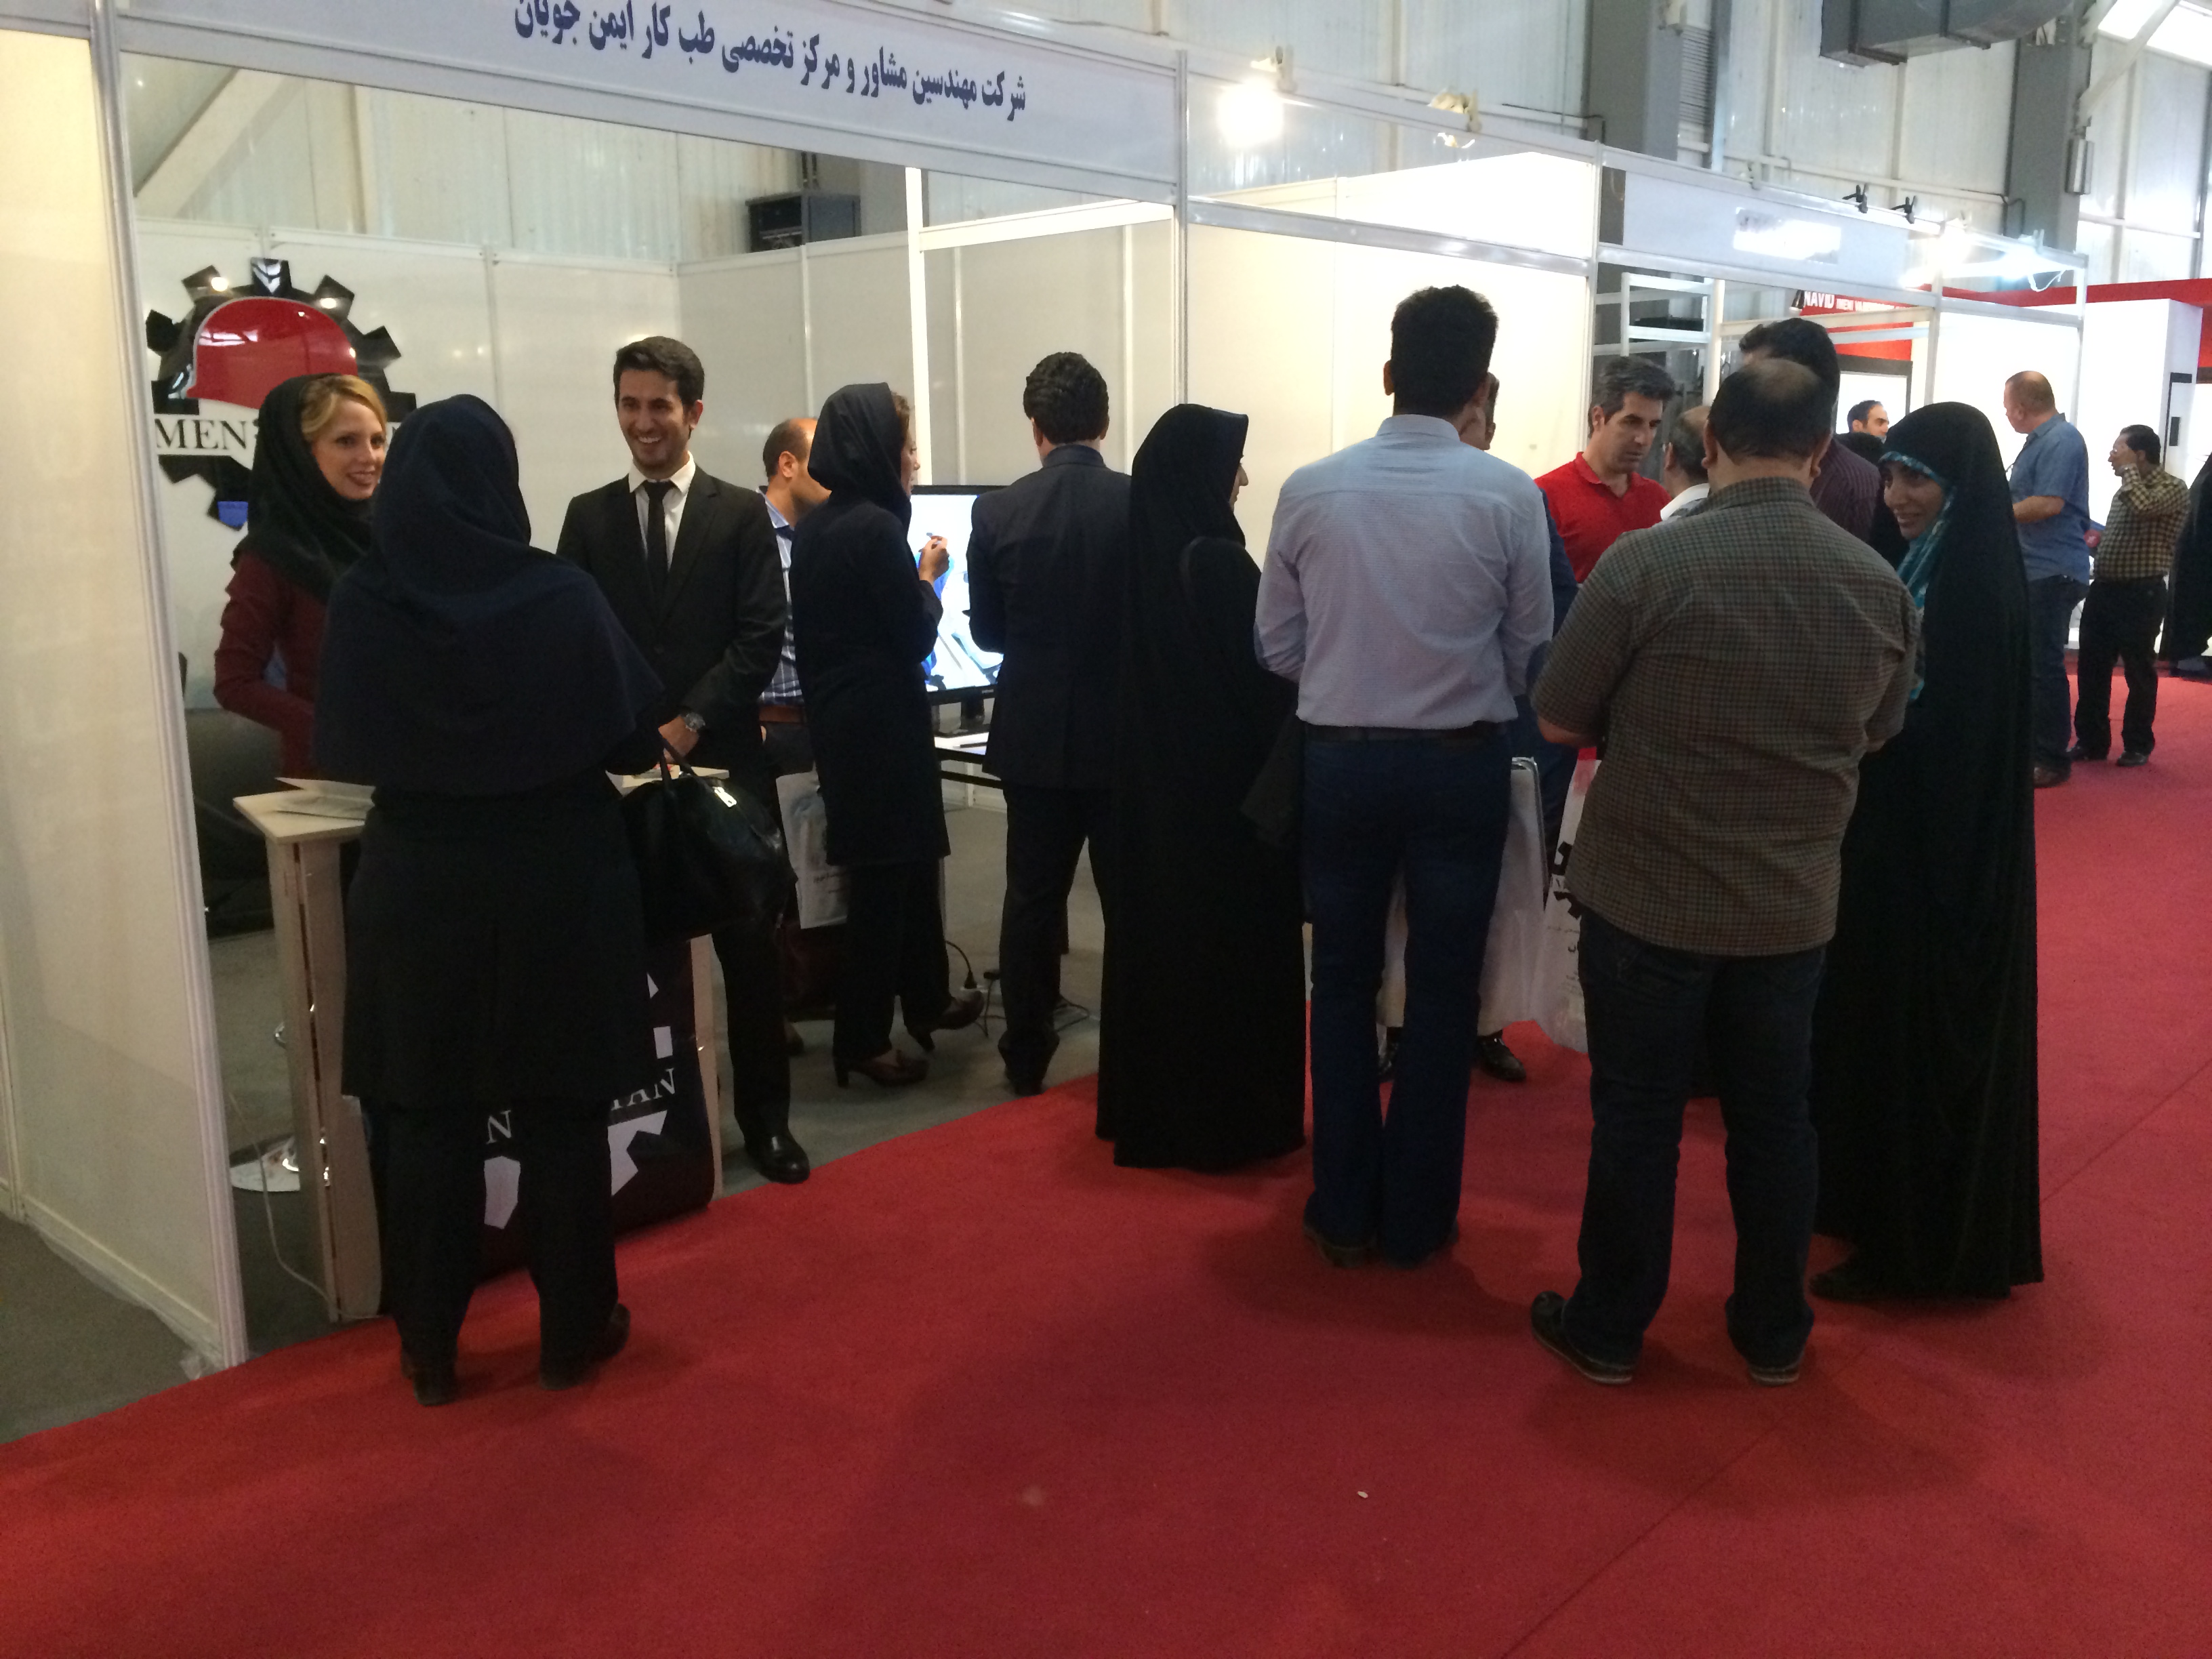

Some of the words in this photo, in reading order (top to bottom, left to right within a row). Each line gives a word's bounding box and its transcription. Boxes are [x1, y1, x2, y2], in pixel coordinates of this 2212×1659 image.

[590, 0, 634, 50] ایمن
[642, 1, 671, 59] کار
[679, 10, 715, 64] طب
[722, 25, 794, 73] تخصصی
[800, 34, 840, 89] مرکز
[846, 58, 855, 94] و
[861, 45, 907, 98] مشاور
[913, 69, 977, 109] مهندسین
[982, 70, 1025, 121] شرکت
[1804, 291, 1835, 308] NAVID
